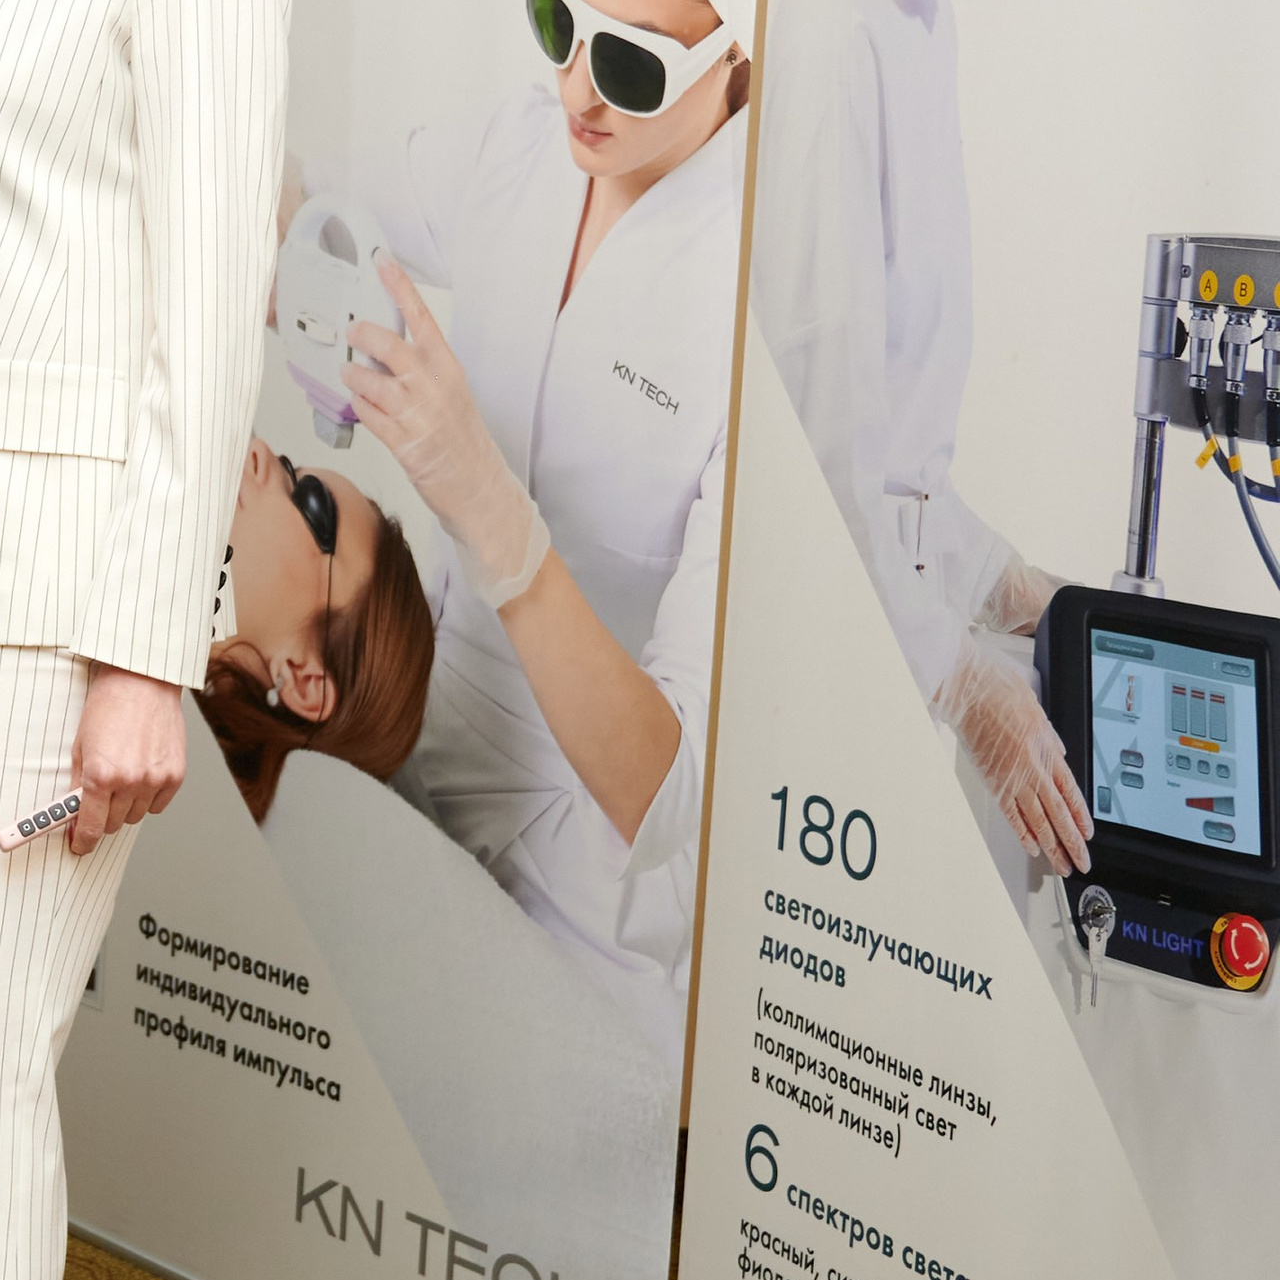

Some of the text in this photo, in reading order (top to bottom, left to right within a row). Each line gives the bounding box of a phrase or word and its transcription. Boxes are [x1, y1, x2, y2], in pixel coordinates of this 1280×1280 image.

[1204, 278, 1212, 293] A
[1240, 283, 1248, 298] B
[612, 360, 679, 415] KN TECH
[770, 786, 877, 881] 180
[139, 913, 310, 995] Формирование
[760, 935, 846, 988] диодов
[764, 889, 993, 1000] светоизлучающих
[1123, 920, 1204, 958] KN LIGHT
[136, 961, 331, 1050] индивидуального
[134, 1005, 342, 1102] профиля импульса
[753, 1031, 957, 1141] поляризованный свет
[756, 987, 997, 1127] (коллимационные линзы,
[752, 1066, 902, 1159] в каждой линзе)
[295, 1166, 383, 1257] KN
[744, 1123, 780, 1193] 6
[787, 1184, 894, 1257] спектров
[740, 1218, 819, 1280] красный,
